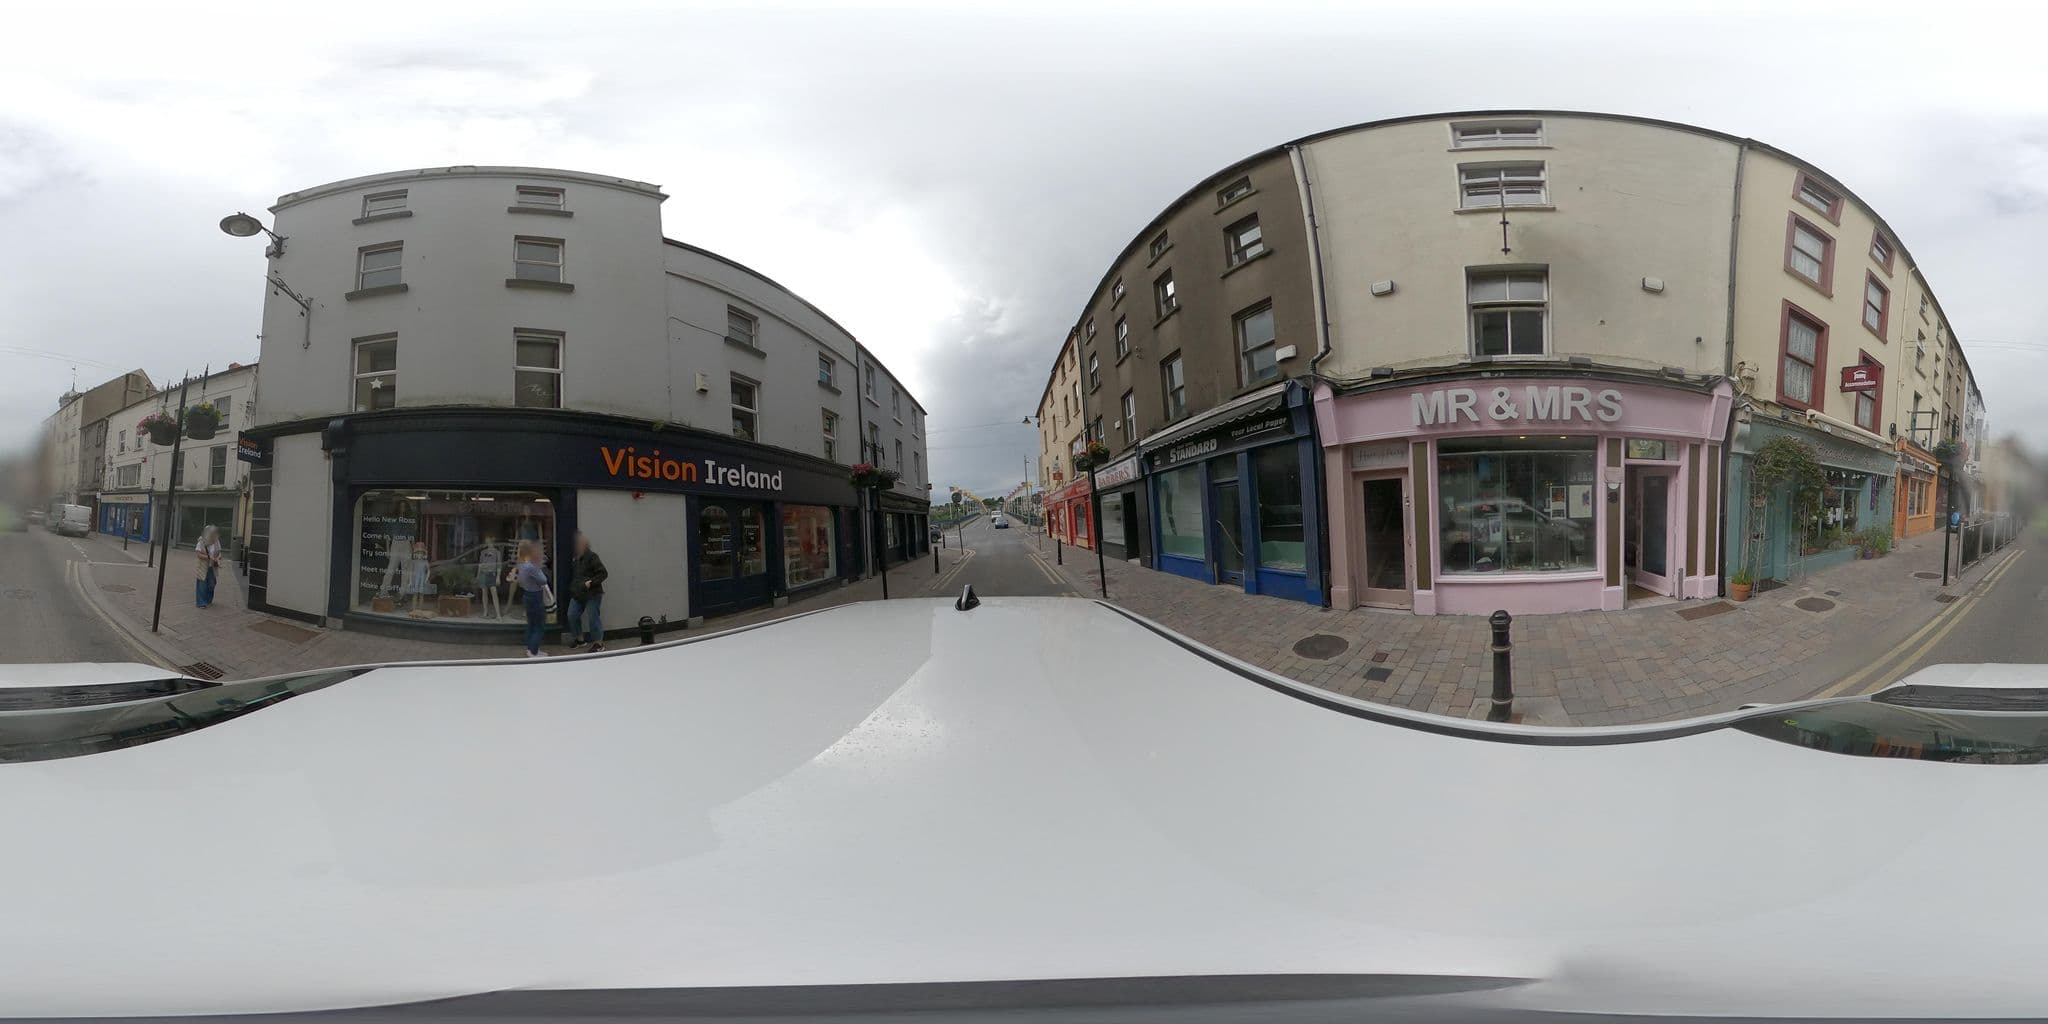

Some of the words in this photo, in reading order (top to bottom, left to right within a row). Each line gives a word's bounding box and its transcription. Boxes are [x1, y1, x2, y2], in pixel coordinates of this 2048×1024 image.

[1411, 388, 1480, 425] MR
[1487, 386, 1519, 421] &
[1525, 386, 1623, 422] MRS
[238, 446, 261, 458] Ireland
[601, 447, 697, 482] Vision
[704, 459, 782, 491] Ireland
[362, 549, 373, 557] Try
